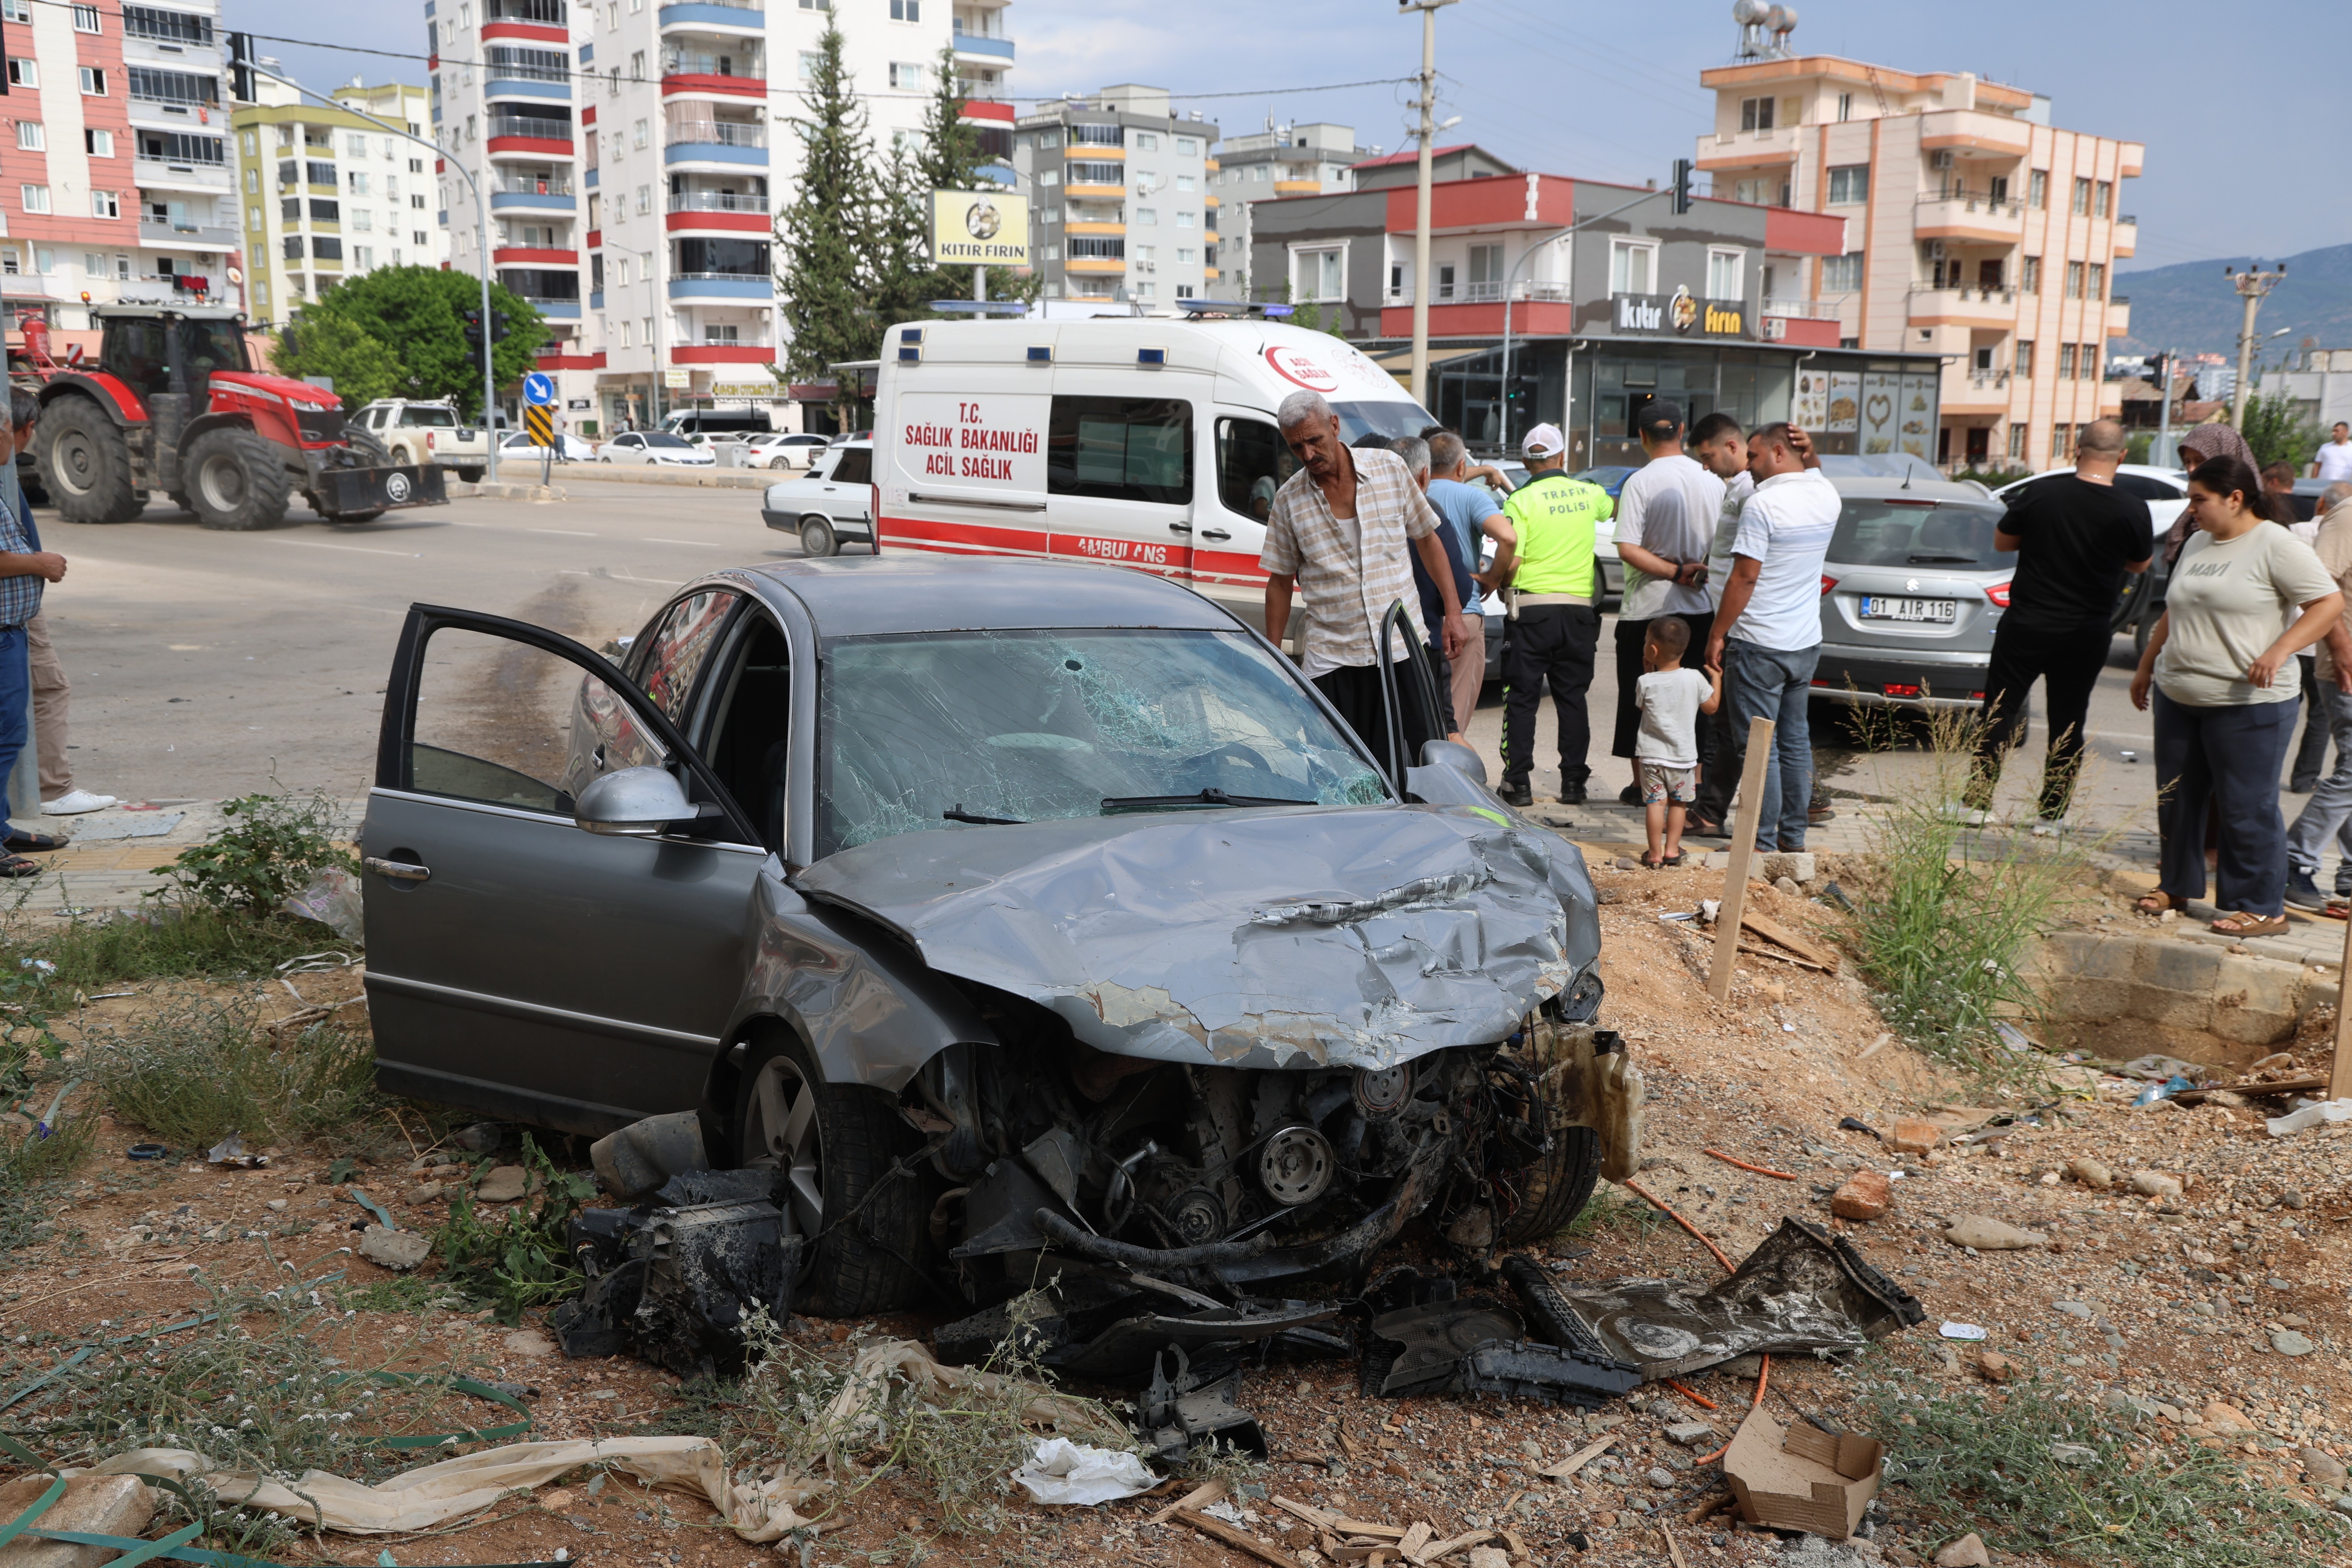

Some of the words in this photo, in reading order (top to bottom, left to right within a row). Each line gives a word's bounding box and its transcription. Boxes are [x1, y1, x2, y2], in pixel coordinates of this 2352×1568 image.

[942, 243, 982, 256] KITIR
[985, 245, 1024, 257] FIRIN
[960, 403, 982, 424] T.C.
[906, 422, 953, 447] SAĞLIK
[961, 428, 1038, 454] BAKANLIĞI
[926, 452, 956, 476] ACİL
[962, 454, 1013, 480] SAĞLIK
[1871, 599, 1886, 613] 01
[1900, 600, 1923, 615] AIR
[1930, 602, 1953, 617] 116
